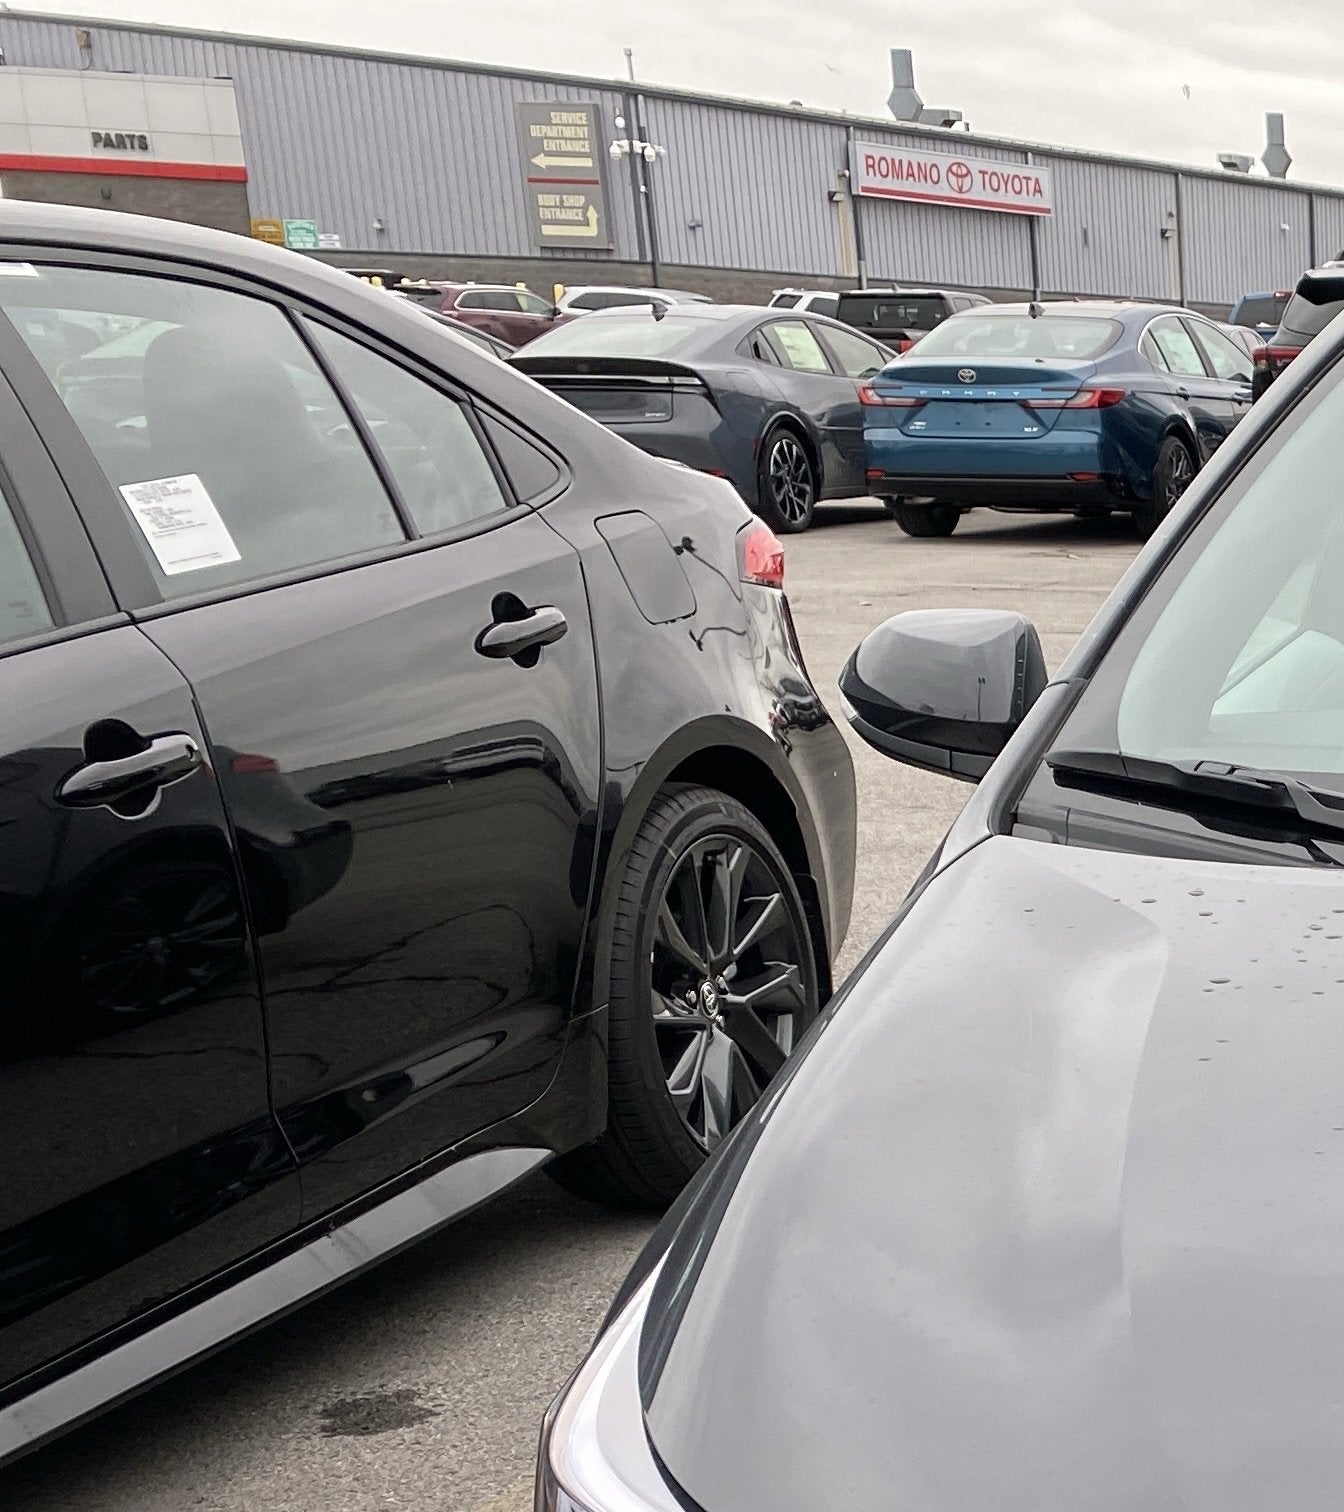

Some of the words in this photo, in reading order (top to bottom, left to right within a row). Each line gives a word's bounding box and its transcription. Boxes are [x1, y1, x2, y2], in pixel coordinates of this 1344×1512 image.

[550, 111, 588, 125] SERVICE
[529, 124, 589, 138] DEPARTMENT
[91, 131, 149, 151] PARTS
[543, 138, 591, 153] ENTRANCE
[864, 153, 941, 186] ROMANO
[978, 169, 1044, 198] TOYOTA
